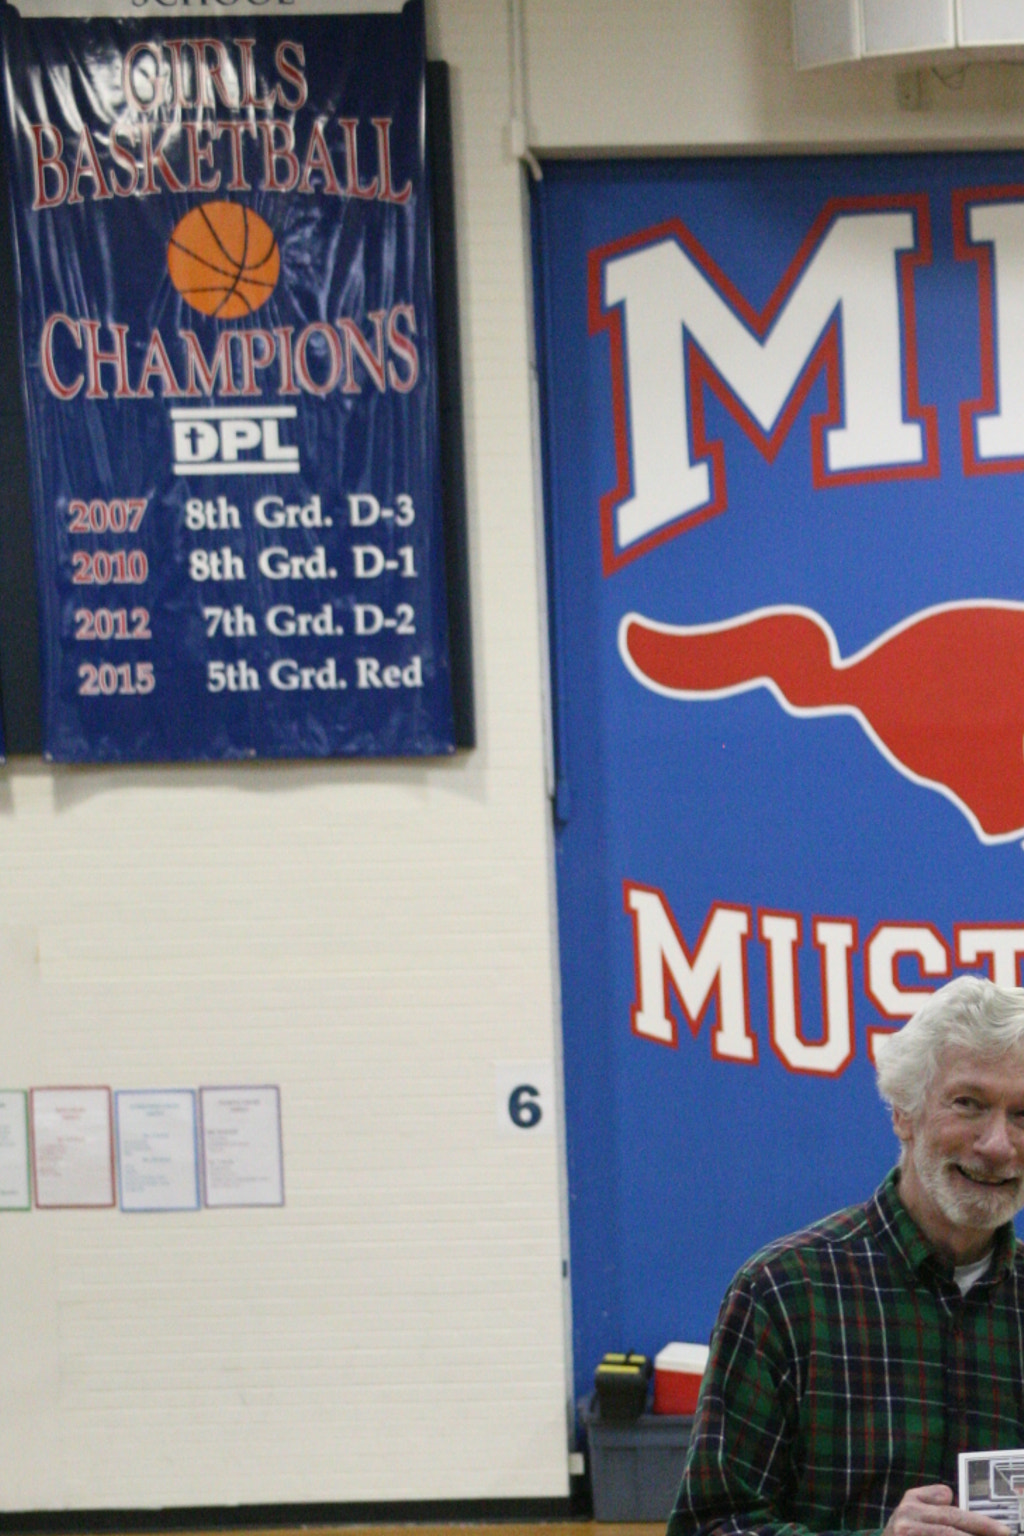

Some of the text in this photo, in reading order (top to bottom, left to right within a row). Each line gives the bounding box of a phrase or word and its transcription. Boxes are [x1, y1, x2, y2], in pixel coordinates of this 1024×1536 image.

[123, 38, 309, 111] GIRLS
[31, 118, 413, 210] BASKETBALL
[40, 304, 420, 400] CHAMPIONS
[173, 418, 301, 463] DPL
[67, 494, 416, 533] 2007 8th Grd. D-3
[71, 545, 418, 584] 2010 8th Grd. D-1
[74, 603, 417, 640] 2012 7th Grd. D-2
[78, 656, 424, 695] 2015 5th Grd. Red
[508, 1084, 542, 1129] 6
